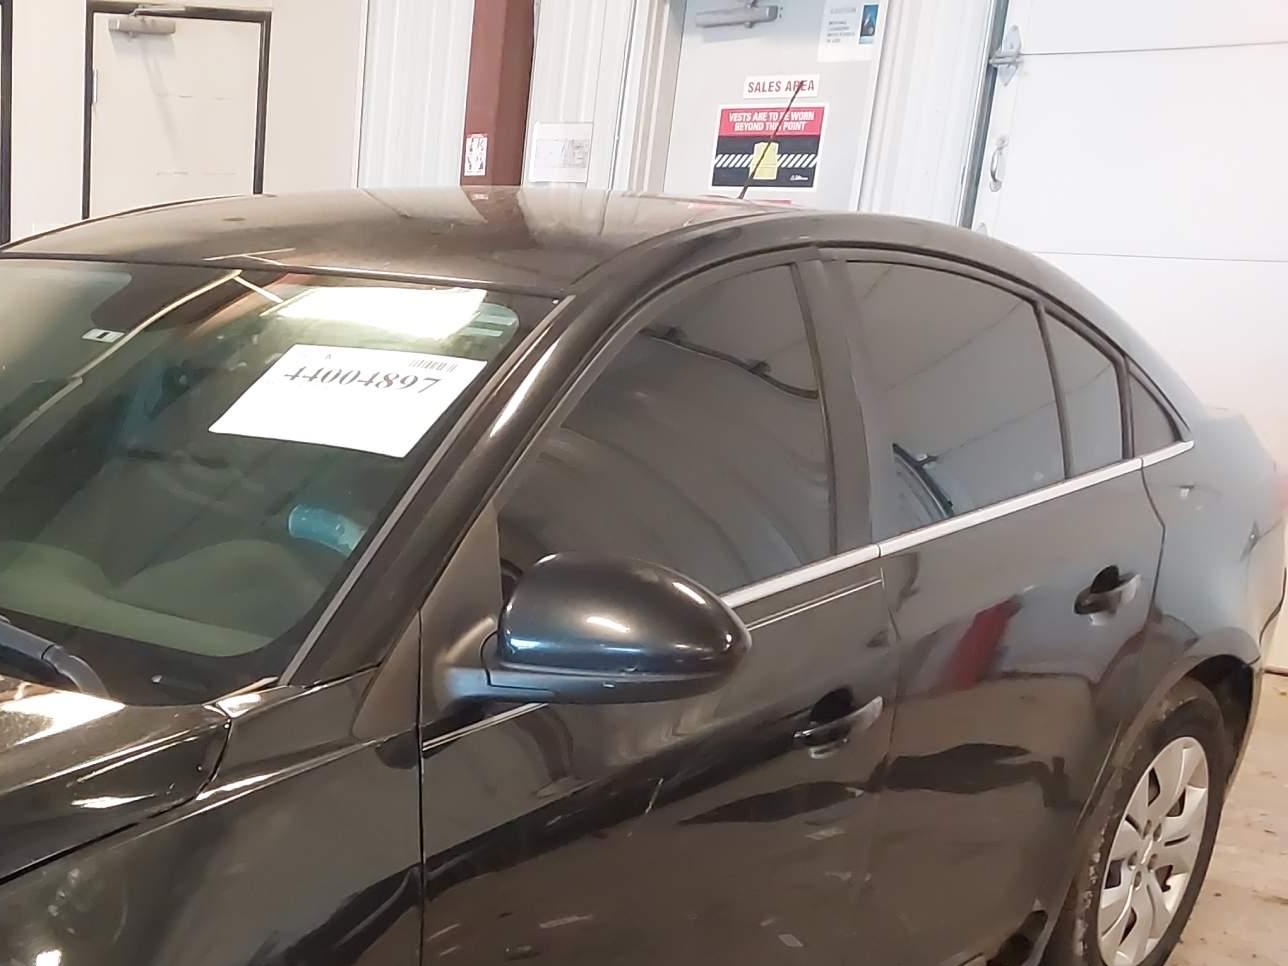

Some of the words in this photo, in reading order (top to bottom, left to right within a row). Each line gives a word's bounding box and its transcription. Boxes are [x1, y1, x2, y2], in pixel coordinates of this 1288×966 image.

[747, 80, 782, 93] SALES
[784, 79, 815, 92] AREA
[729, 112, 752, 122] VESTS
[752, 112, 768, 122] ARE
[769, 112, 778, 121] TO
[791, 111, 815, 121] WORN
[734, 121, 764, 132] BEYOND
[783, 121, 808, 131] POINT
[283, 366, 442, 394] 44004897
